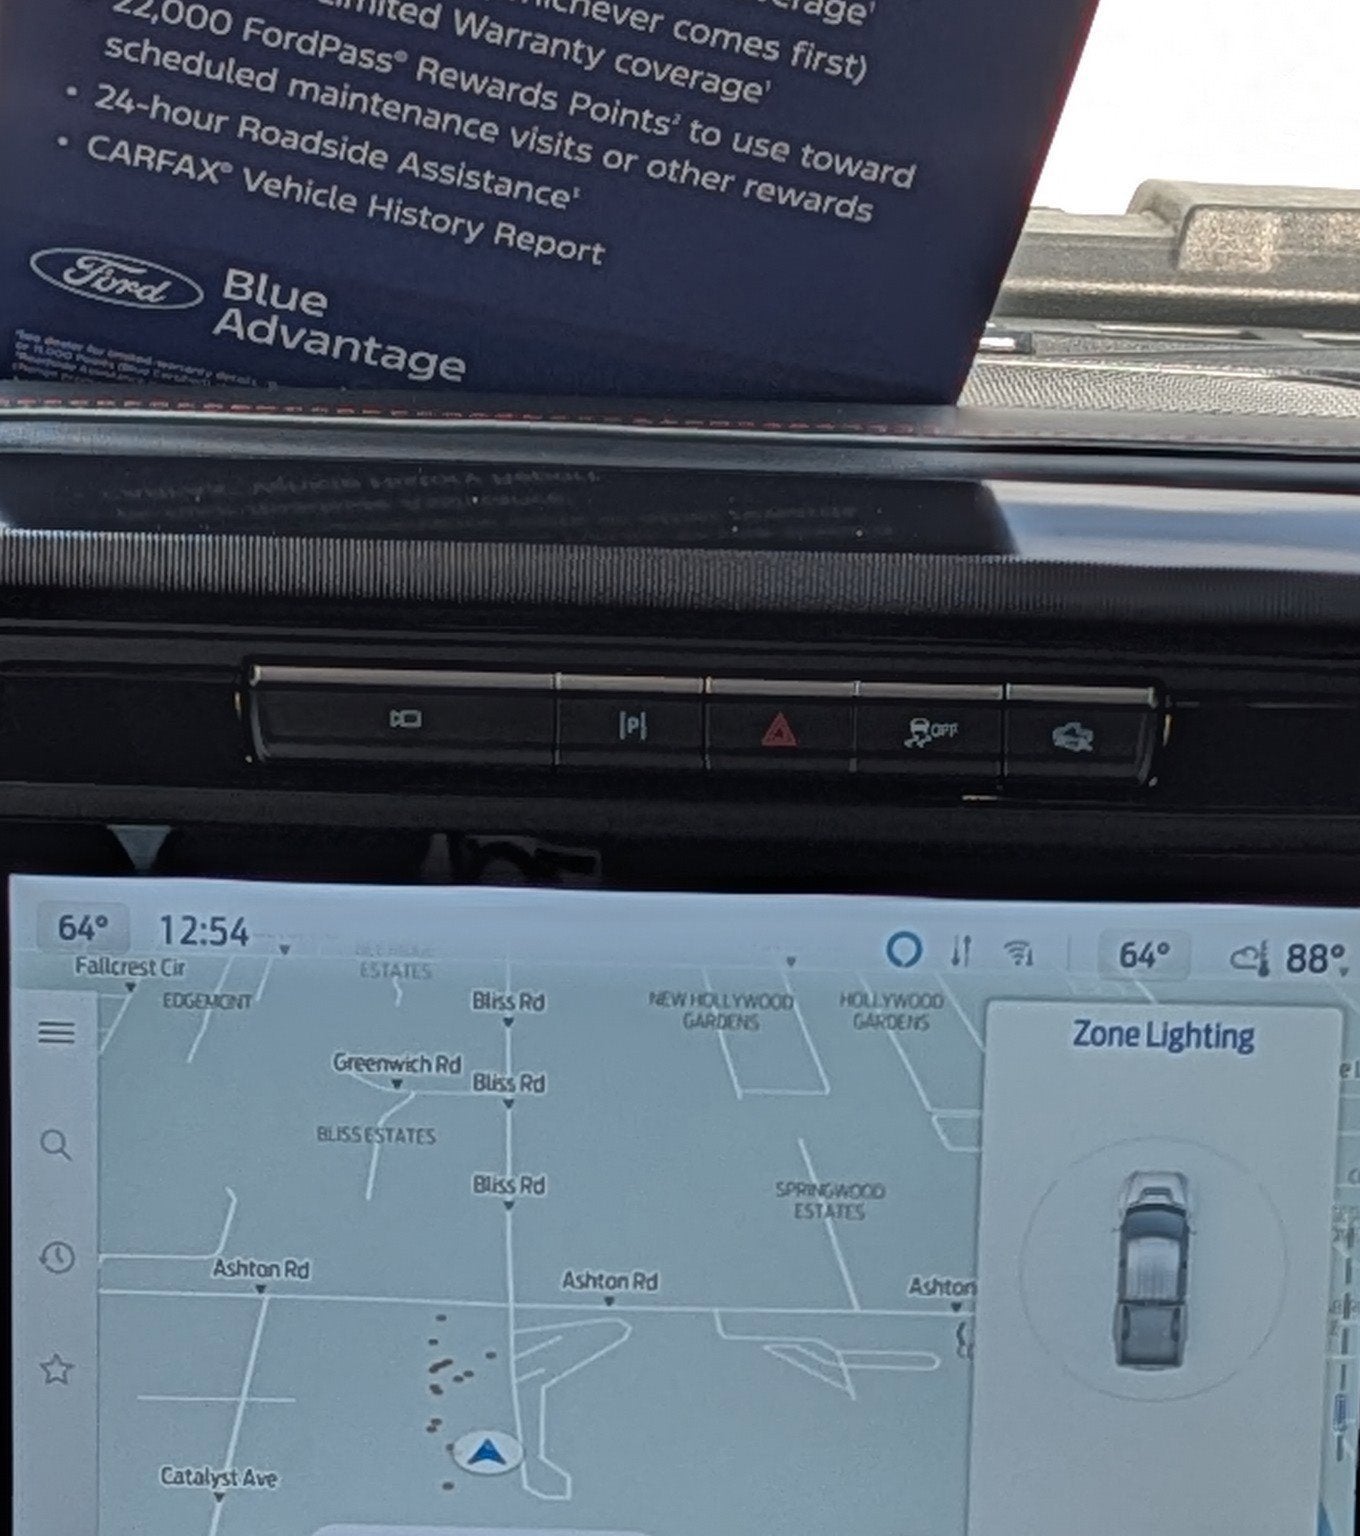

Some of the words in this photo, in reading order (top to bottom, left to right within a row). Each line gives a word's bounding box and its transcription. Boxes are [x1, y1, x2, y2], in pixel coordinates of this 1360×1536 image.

[453, 9, 606, 71] Warranty
[672, 17, 780, 61] comes
[790, 40, 868, 86] first)
[95, 84, 229, 136] 24-hour
[237, 116, 390, 170] Roadside
[104, 36, 279, 93] scheduled
[287, 77, 500, 144] maintenance
[510, 126, 594, 164] visits
[602, 148, 640, 173] or
[646, 158, 735, 194] other
[743, 176, 875, 223] rewards
[416, 56, 558, 111] Rewards
[689, 119, 721, 148] to
[733, 133, 791, 164] use
[801, 143, 917, 190] toward
[242, 167, 357, 214] Vehicle
[367, 194, 484, 244] History
[494, 221, 606, 266] Report
[60, 250, 174, 306] Ford
[221, 268, 329, 317] Blue
[212, 309, 469, 383] Advantage
[58, 914, 110, 942] 64°
[159, 914, 250, 947] 12:54
[75, 956, 157, 977] Fallcrest
[160, 958, 186, 977] Cir
[1118, 942, 1172, 969] 64°
[1286, 944, 1346, 975] 88°
[360, 962, 432, 980] ESTATES
[162, 992, 253, 1010] EDGEMONT
[472, 991, 517, 1012] Bliss
[519, 992, 545, 1012] Rd
[648, 991, 687, 1008] NEW
[689, 993, 794, 1012] HOLLYWOOD
[839, 992, 945, 1012] HOLLYWOOD
[682, 1014, 760, 1031] GARDENS
[853, 1014, 930, 1031] GARDENS
[1072, 1019, 1141, 1048] Zone
[1145, 1021, 1256, 1055] Lighting
[333, 1053, 432, 1075] Greenwich
[436, 1055, 462, 1075] Rd
[472, 1073, 517, 1093] Bliss
[519, 1074, 545, 1093] Rd
[317, 1126, 362, 1143] BLISS
[364, 1127, 436, 1145] ESTATES
[472, 1175, 517, 1195] Bliss
[519, 1176, 545, 1195] Rd
[775, 1182, 887, 1201] SPRINGWOOD
[794, 1203, 865, 1221] ESTATES
[212, 1258, 279, 1280] Ashton
[283, 1260, 310, 1280] Rd
[562, 1270, 629, 1291] Ashton
[632, 1272, 659, 1291] Rd
[908, 1276, 978, 1297] Ashton
[160, 1466, 240, 1492] Catalyst
[242, 1469, 279, 1489] Ave
